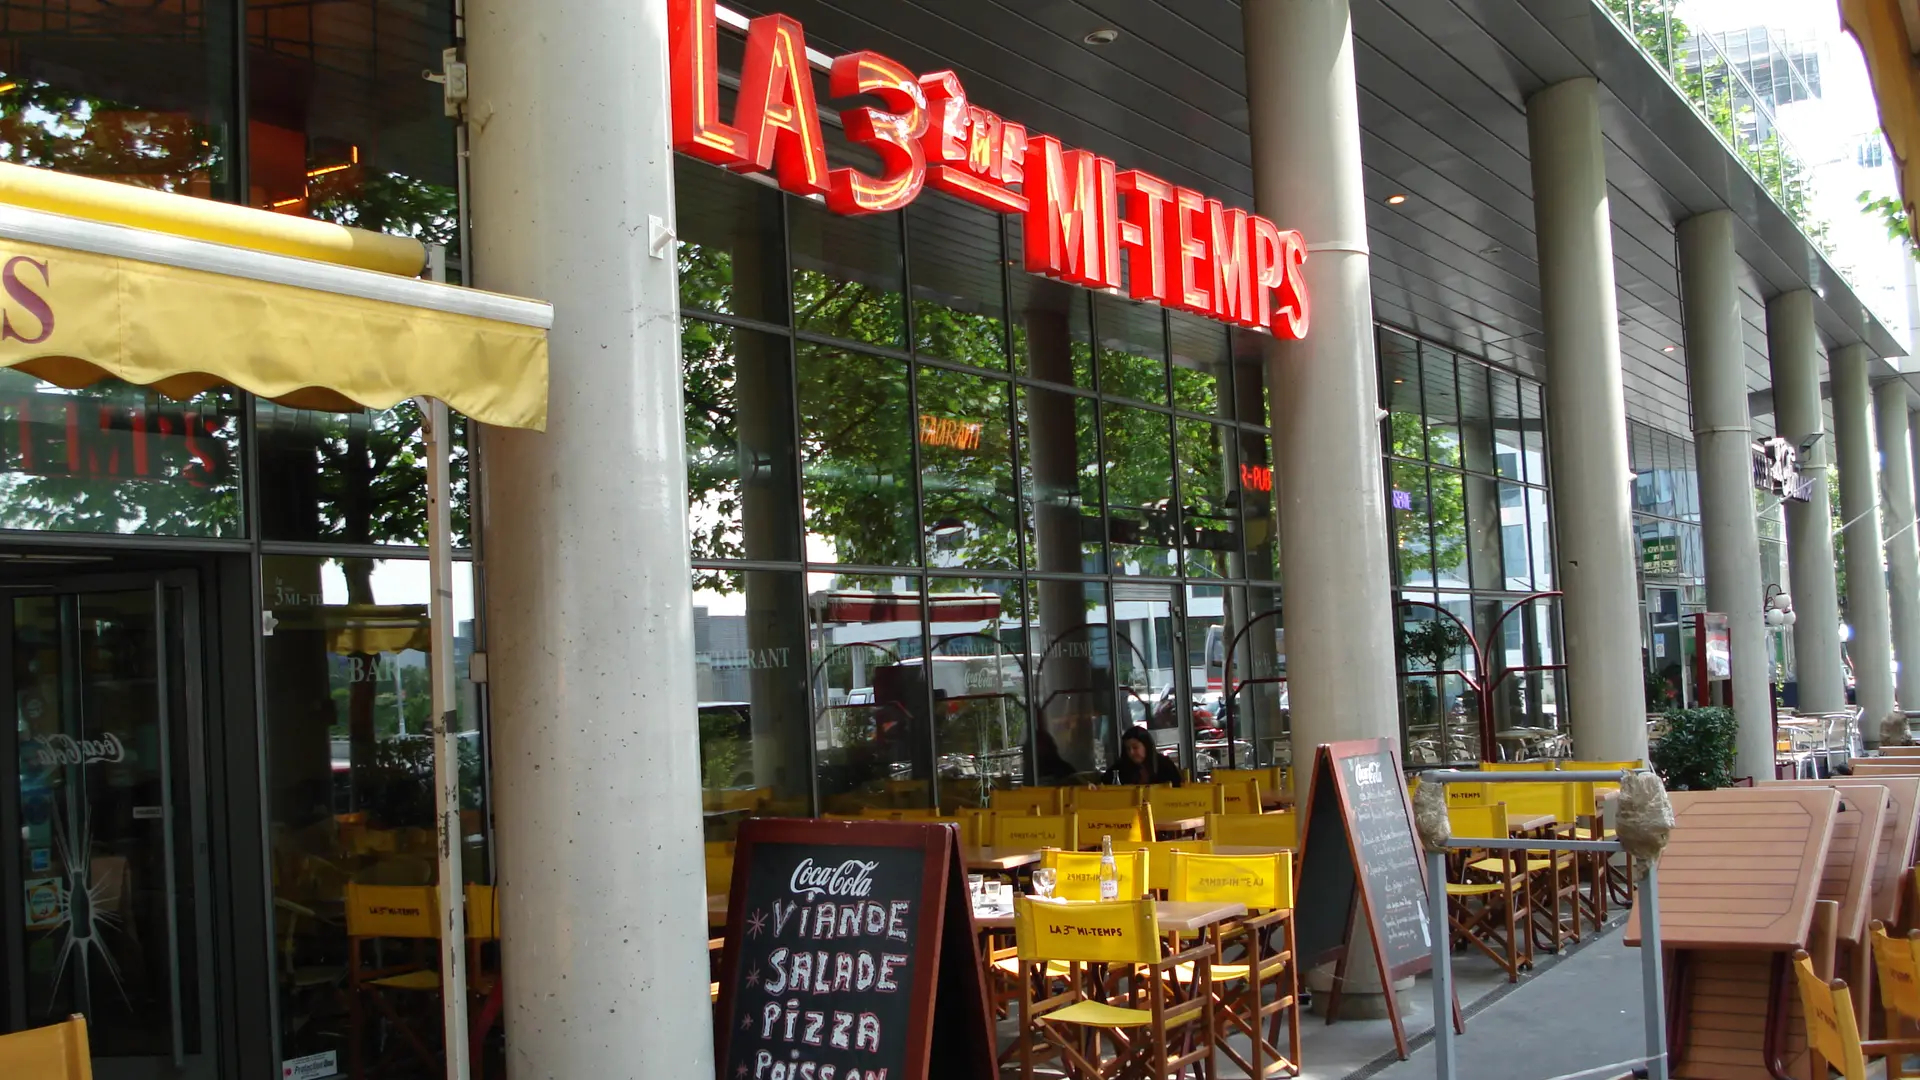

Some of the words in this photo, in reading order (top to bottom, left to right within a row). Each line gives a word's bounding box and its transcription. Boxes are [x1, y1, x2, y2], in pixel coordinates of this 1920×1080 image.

[668, 0, 831, 196] LA
[1023, 134, 1311, 340] MI-TEMPS
[790, 857, 880, 898] Coca-Cola
[1049, 924, 1061, 934] LA
[1077, 926, 1123, 937] MI-TEMPS
[763, 948, 909, 996] SALADE
